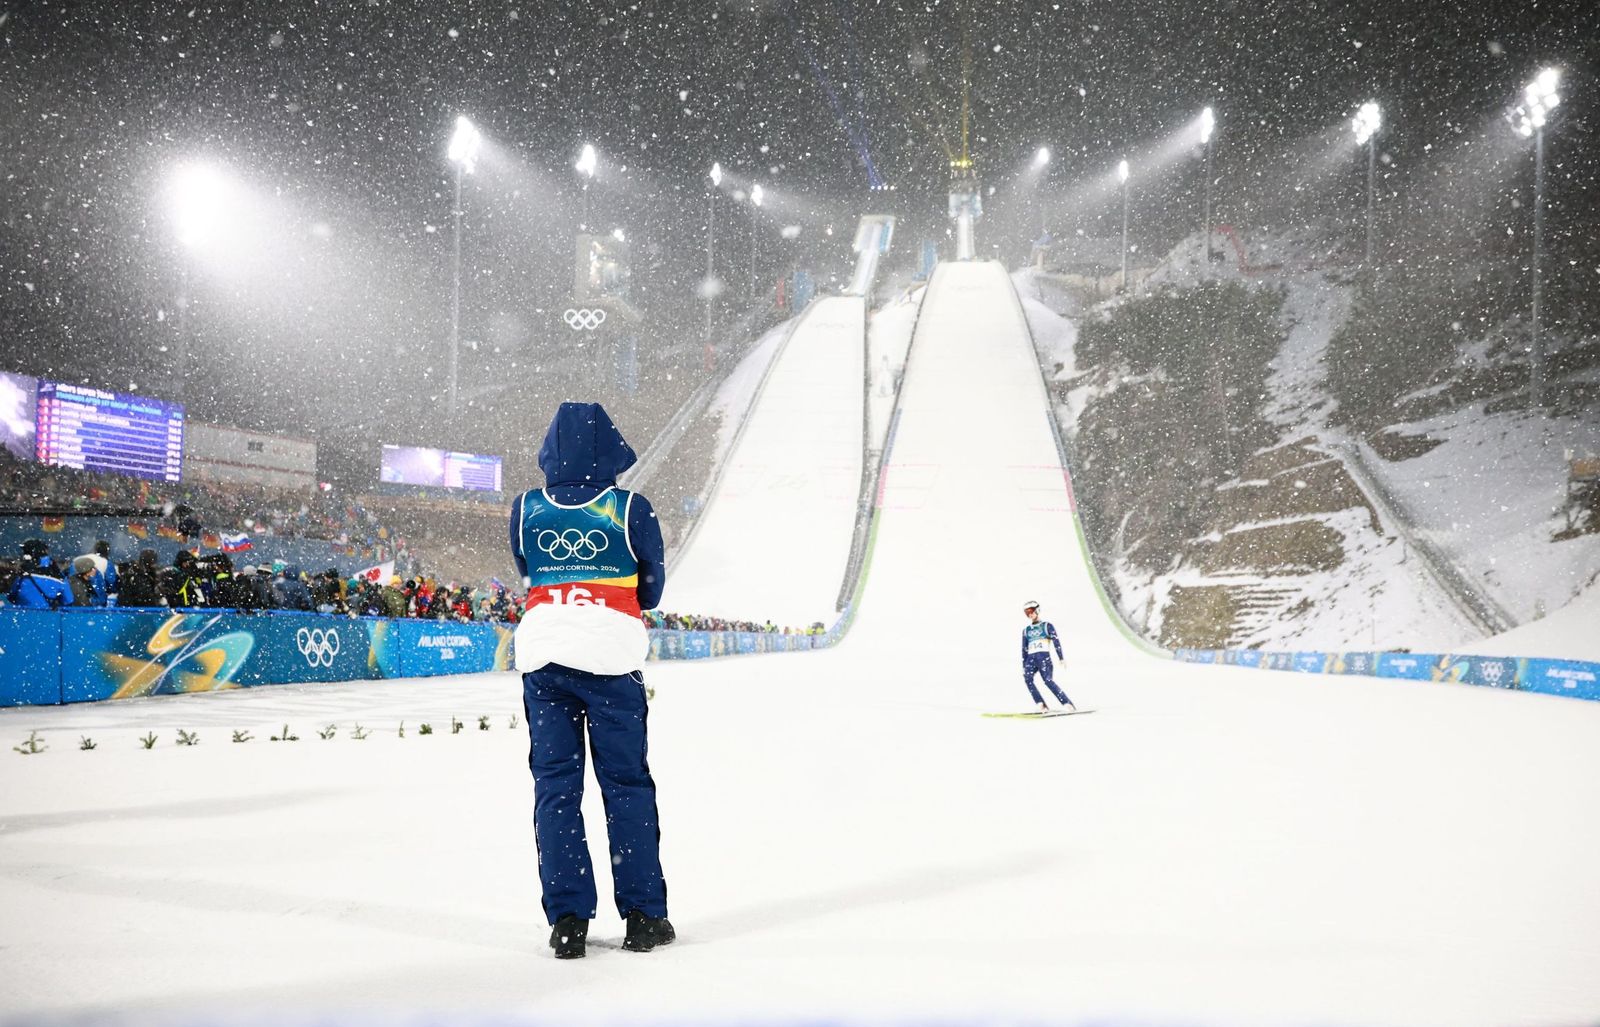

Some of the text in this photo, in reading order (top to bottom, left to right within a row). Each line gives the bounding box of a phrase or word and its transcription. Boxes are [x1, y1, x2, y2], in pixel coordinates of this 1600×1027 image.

[536, 565, 564, 573] MILANO
[600, 565, 616, 573] 2026
[417, 635, 446, 647] MILANO
